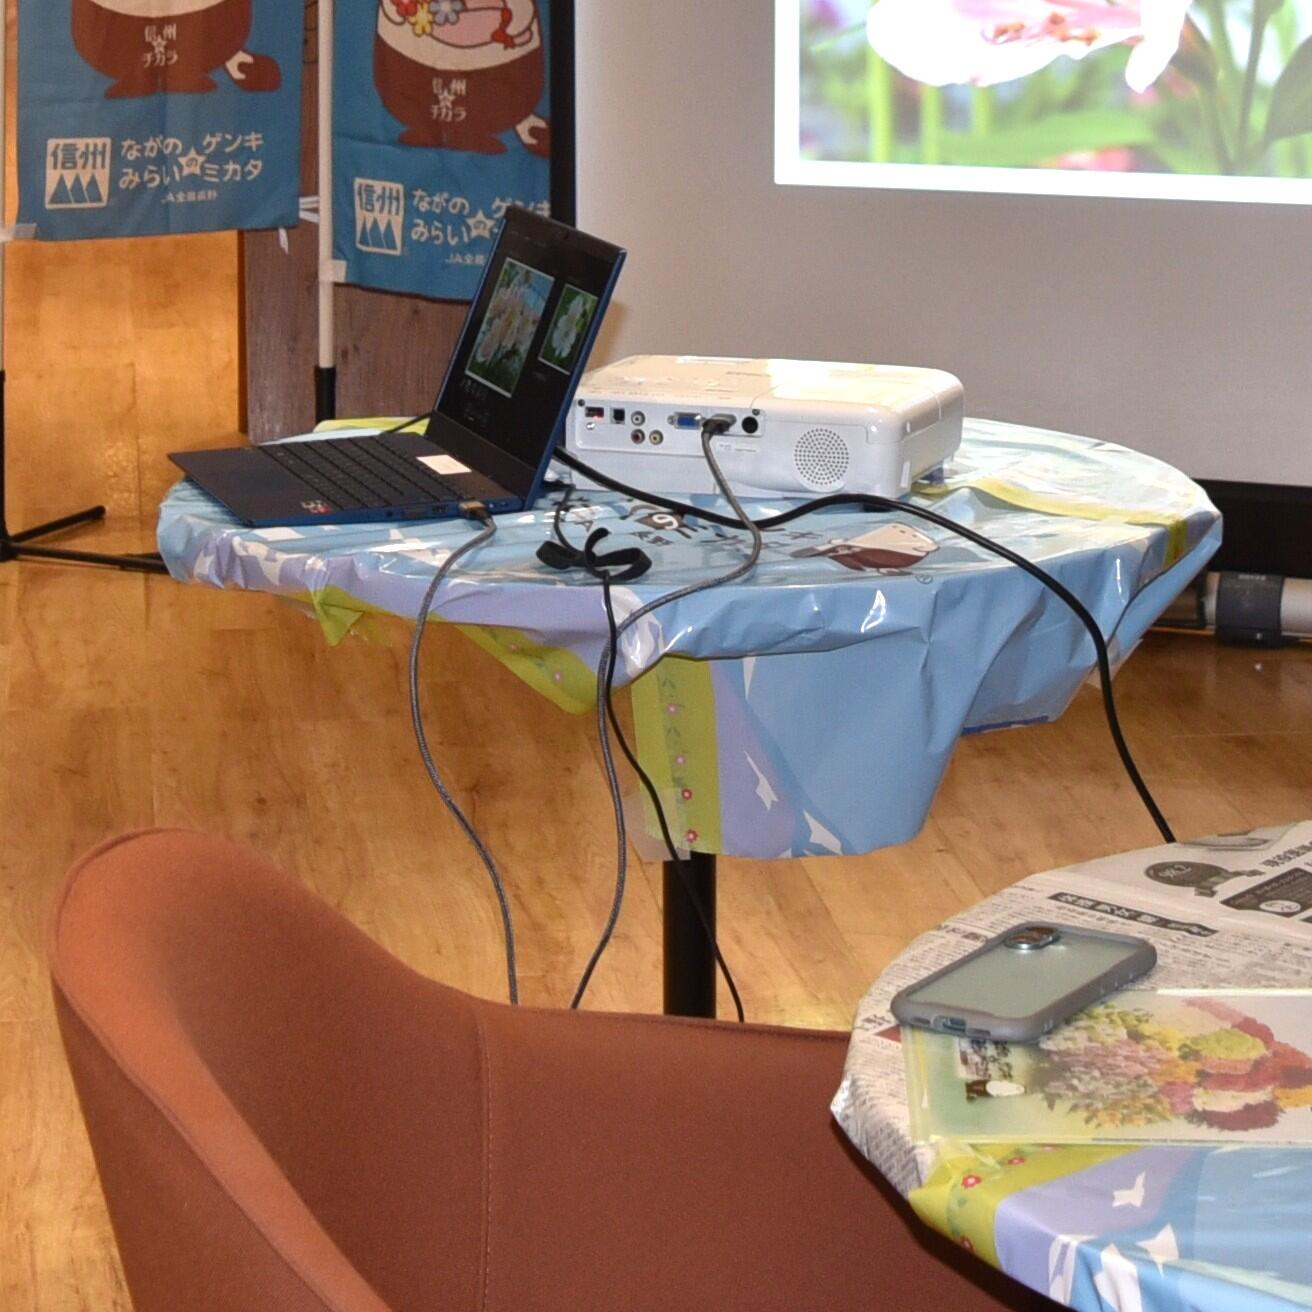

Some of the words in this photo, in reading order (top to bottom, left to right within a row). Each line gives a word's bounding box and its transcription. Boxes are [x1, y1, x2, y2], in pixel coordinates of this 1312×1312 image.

[51, 143, 107, 170] 信州
[121, 134, 183, 160] ながの
[203, 132, 264, 153] ゲンキ
[119, 167, 181, 189] みらい
[203, 160, 263, 182] ミカタ
[357, 184, 401, 215] 信州
[413, 189, 470, 214] ながの
[411, 219, 469, 245] みらい
